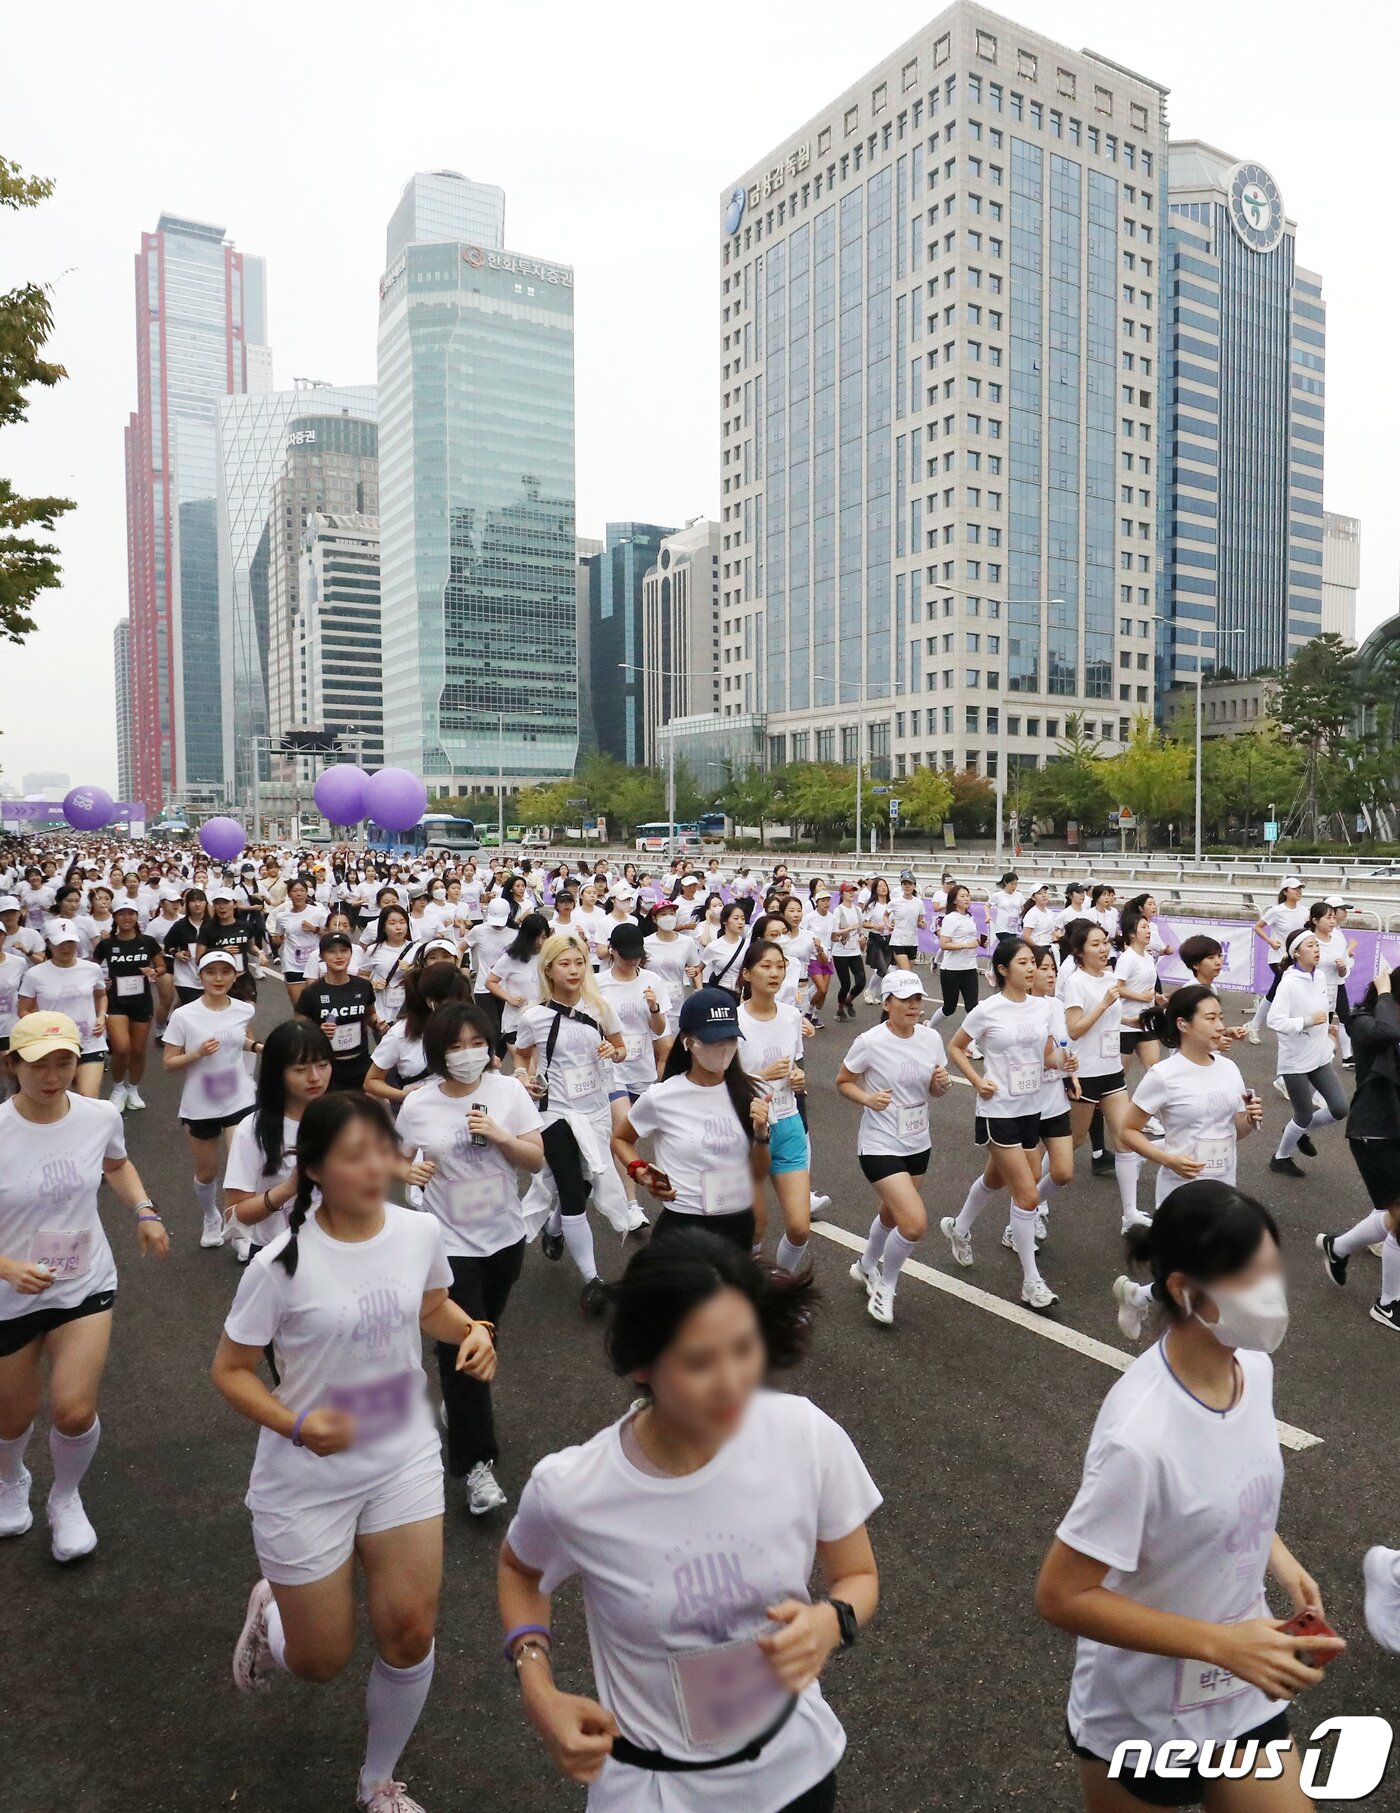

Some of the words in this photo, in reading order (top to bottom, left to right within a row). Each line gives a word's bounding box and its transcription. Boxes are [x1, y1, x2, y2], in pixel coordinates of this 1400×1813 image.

[747, 141, 811, 210] 금융감독원
[487, 253, 573, 288] 한화투자증권
[110, 953, 148, 963] PACER
[320, 1004, 366, 1019] PACER
